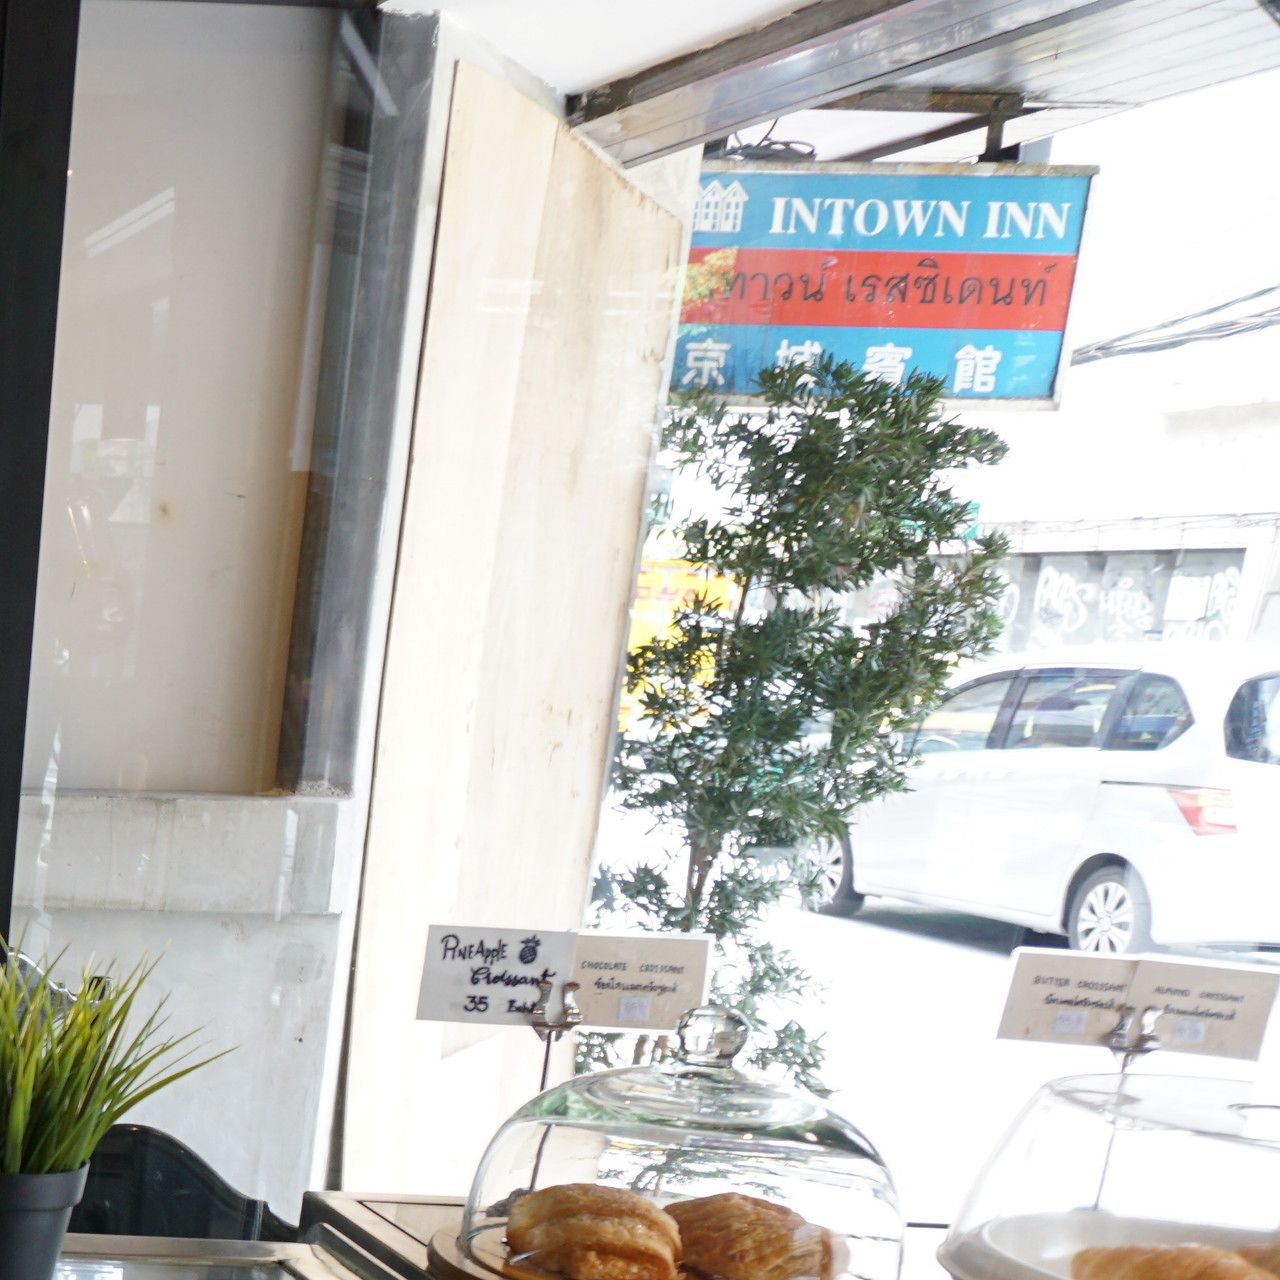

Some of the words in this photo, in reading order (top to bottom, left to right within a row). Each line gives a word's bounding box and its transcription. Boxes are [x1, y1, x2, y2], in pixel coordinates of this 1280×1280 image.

[768, 196, 969, 239] INTOWN
[982, 200, 1072, 240] INN
[463, 995, 489, 1013] 35
